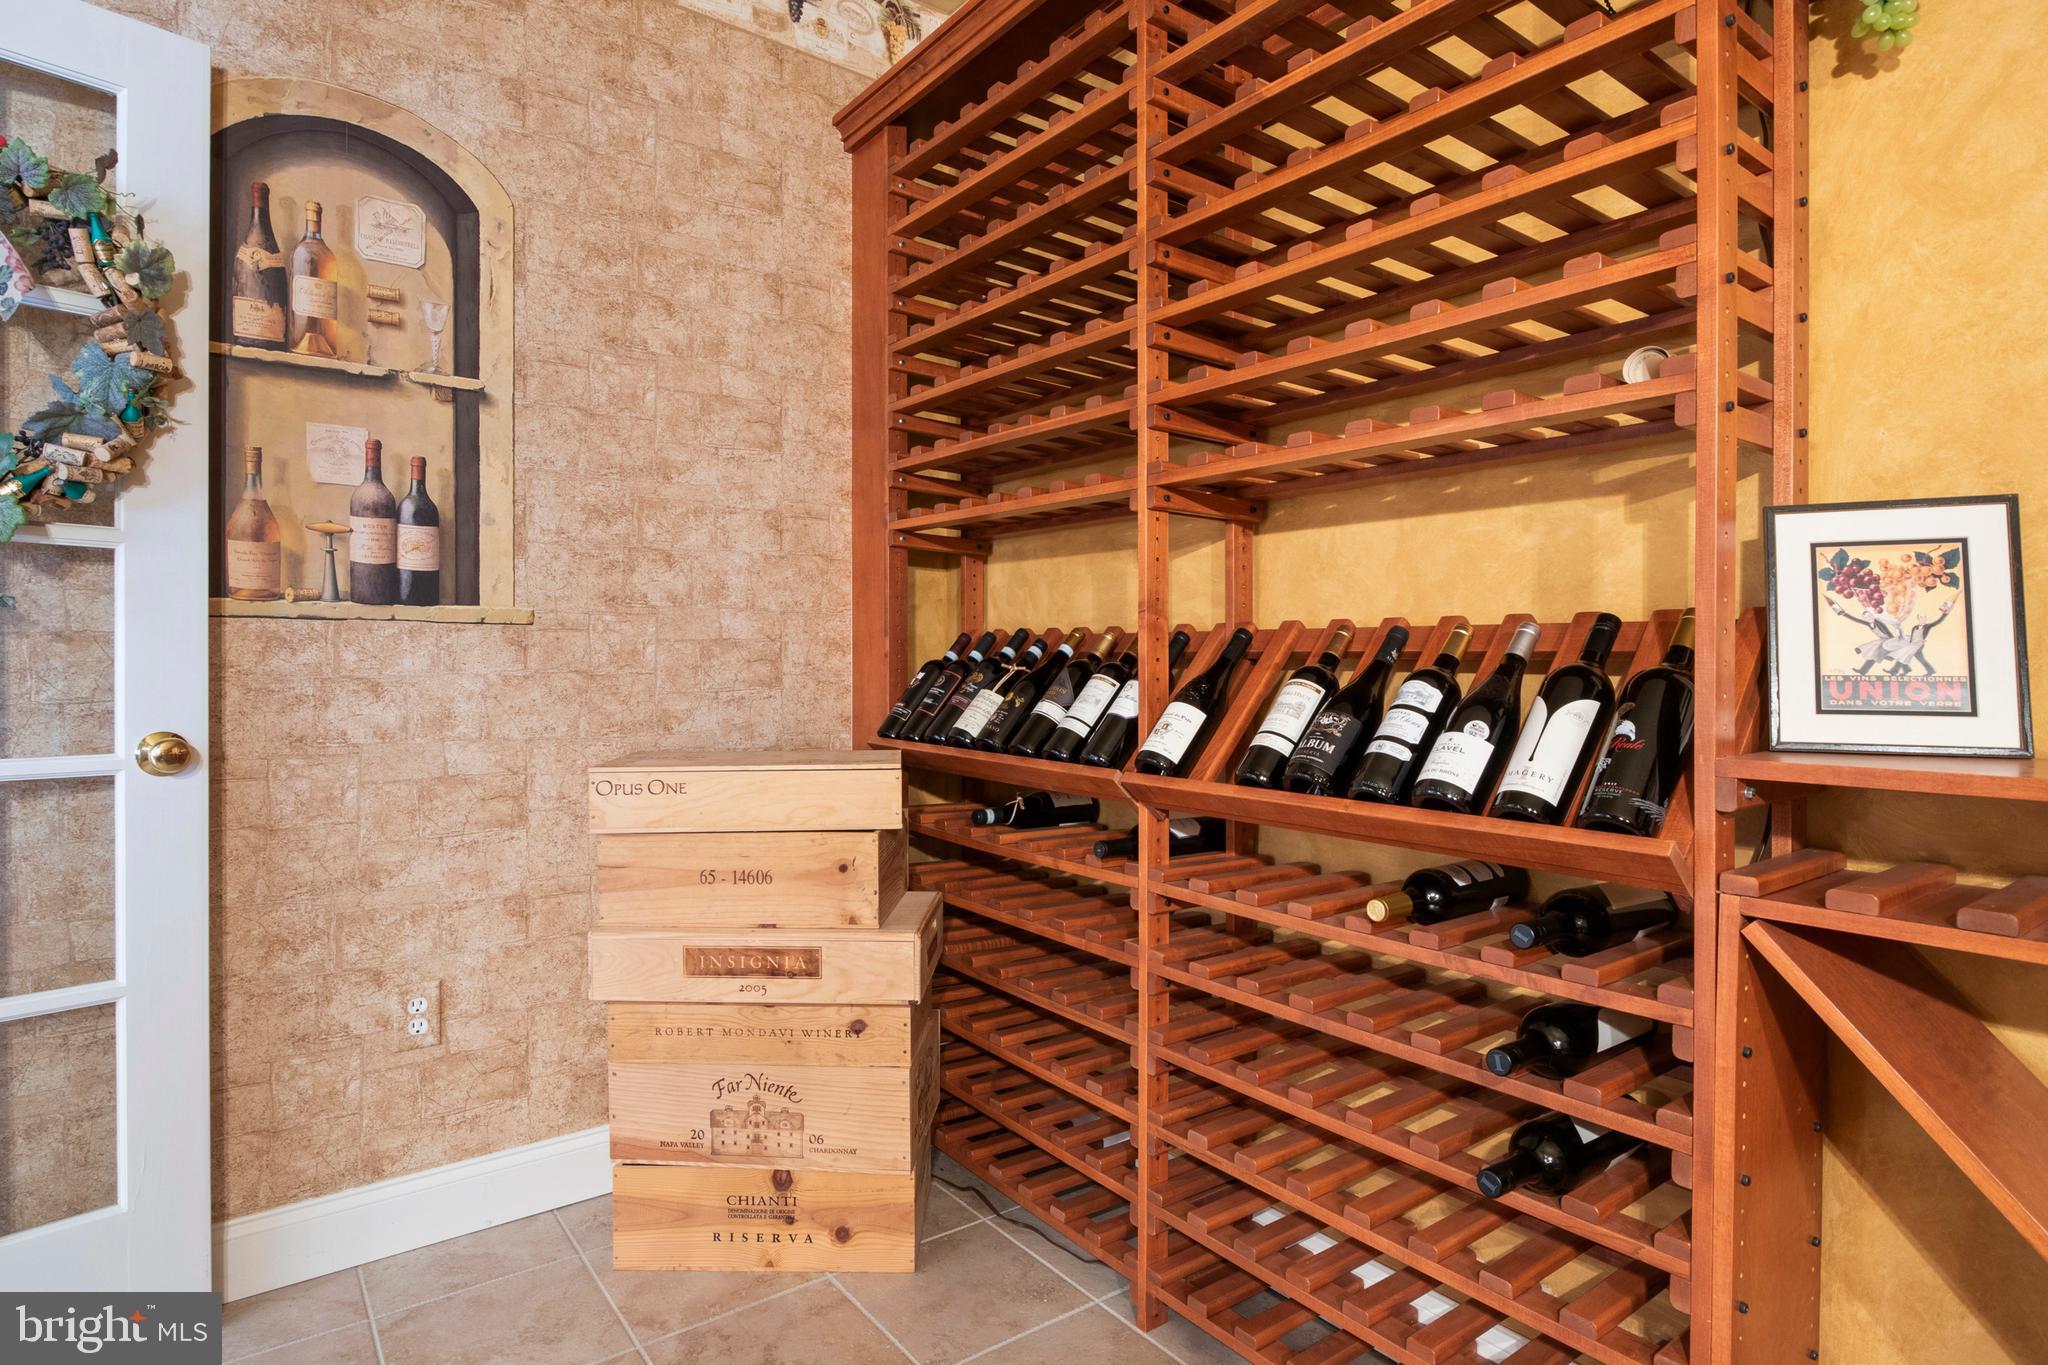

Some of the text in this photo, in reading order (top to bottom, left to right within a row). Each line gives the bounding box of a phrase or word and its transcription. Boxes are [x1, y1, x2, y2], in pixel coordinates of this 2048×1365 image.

[1828, 680, 1962, 701] UNION
[699, 869, 716, 885] 65
[732, 869, 773, 886] 14606
[699, 954, 806, 970] INSIGNIA
[738, 983, 768, 997] 2005
[655, 1027, 862, 1039] ROBERT MONDAVI WINERY
[711, 1072, 804, 1104] Far Niente
[690, 1129, 825, 1145] 20 06
[660, 1140, 705, 1149] NAPA VALLEY
[808, 1147, 858, 1155] CHARDONNAY
[726, 1194, 797, 1207] CHIANTI
[712, 1231, 814, 1244] RISERVA
